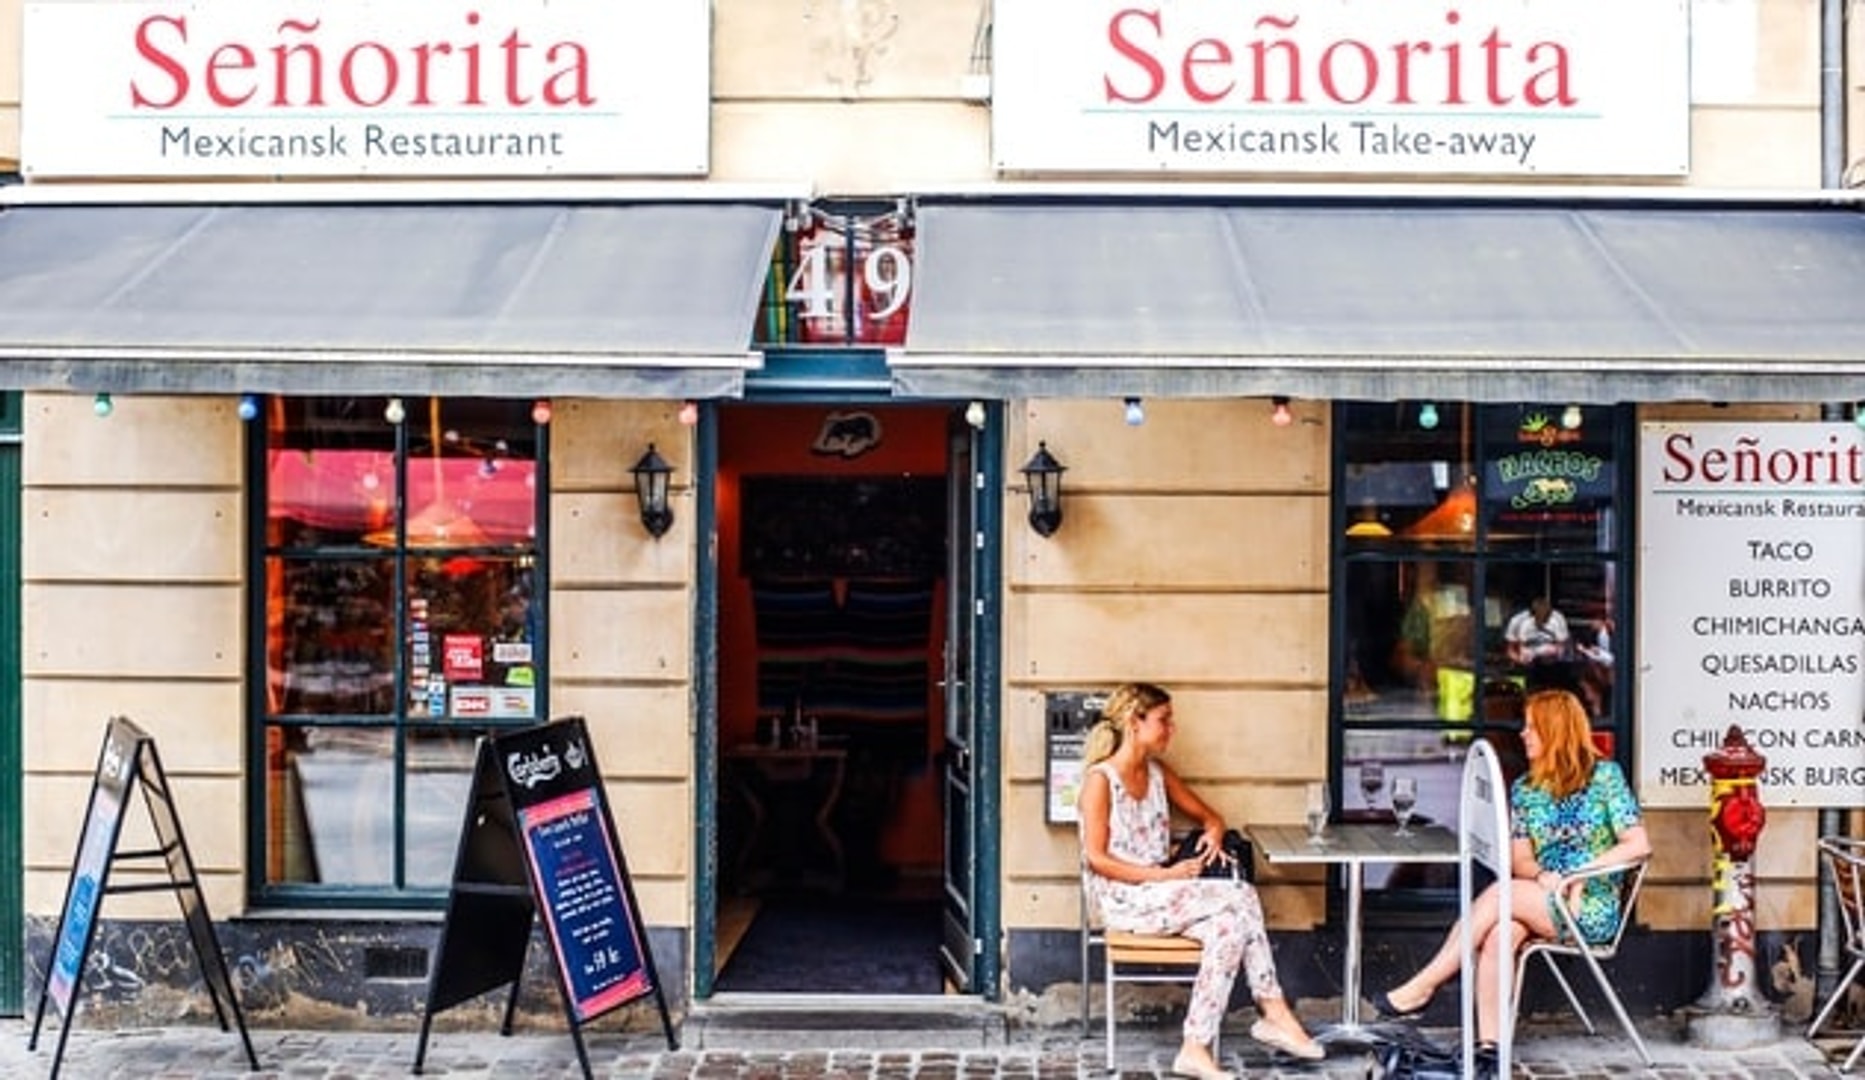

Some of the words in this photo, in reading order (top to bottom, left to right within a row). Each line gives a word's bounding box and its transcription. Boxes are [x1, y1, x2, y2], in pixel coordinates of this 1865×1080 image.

[130, 12, 598, 110] Señorita
[1104, 9, 1579, 108] Señorita
[161, 126, 347, 158] Mexicansk
[365, 124, 563, 157] Restaurant
[1149, 121, 1340, 155] Mexicansk
[1351, 122, 1536, 164] Take-away
[785, 245, 911, 320] 49
[1676, 499, 1775, 518] Mexicansk
[1747, 541, 1814, 562] TACO
[1729, 579, 1831, 600] BURRITO
[1692, 616, 1865, 638] CHIMICHANGA
[1701, 654, 1858, 677] QUESADILLAS
[1729, 691, 1831, 712] NACHOS
[1672, 728, 1728, 749] CHIL
